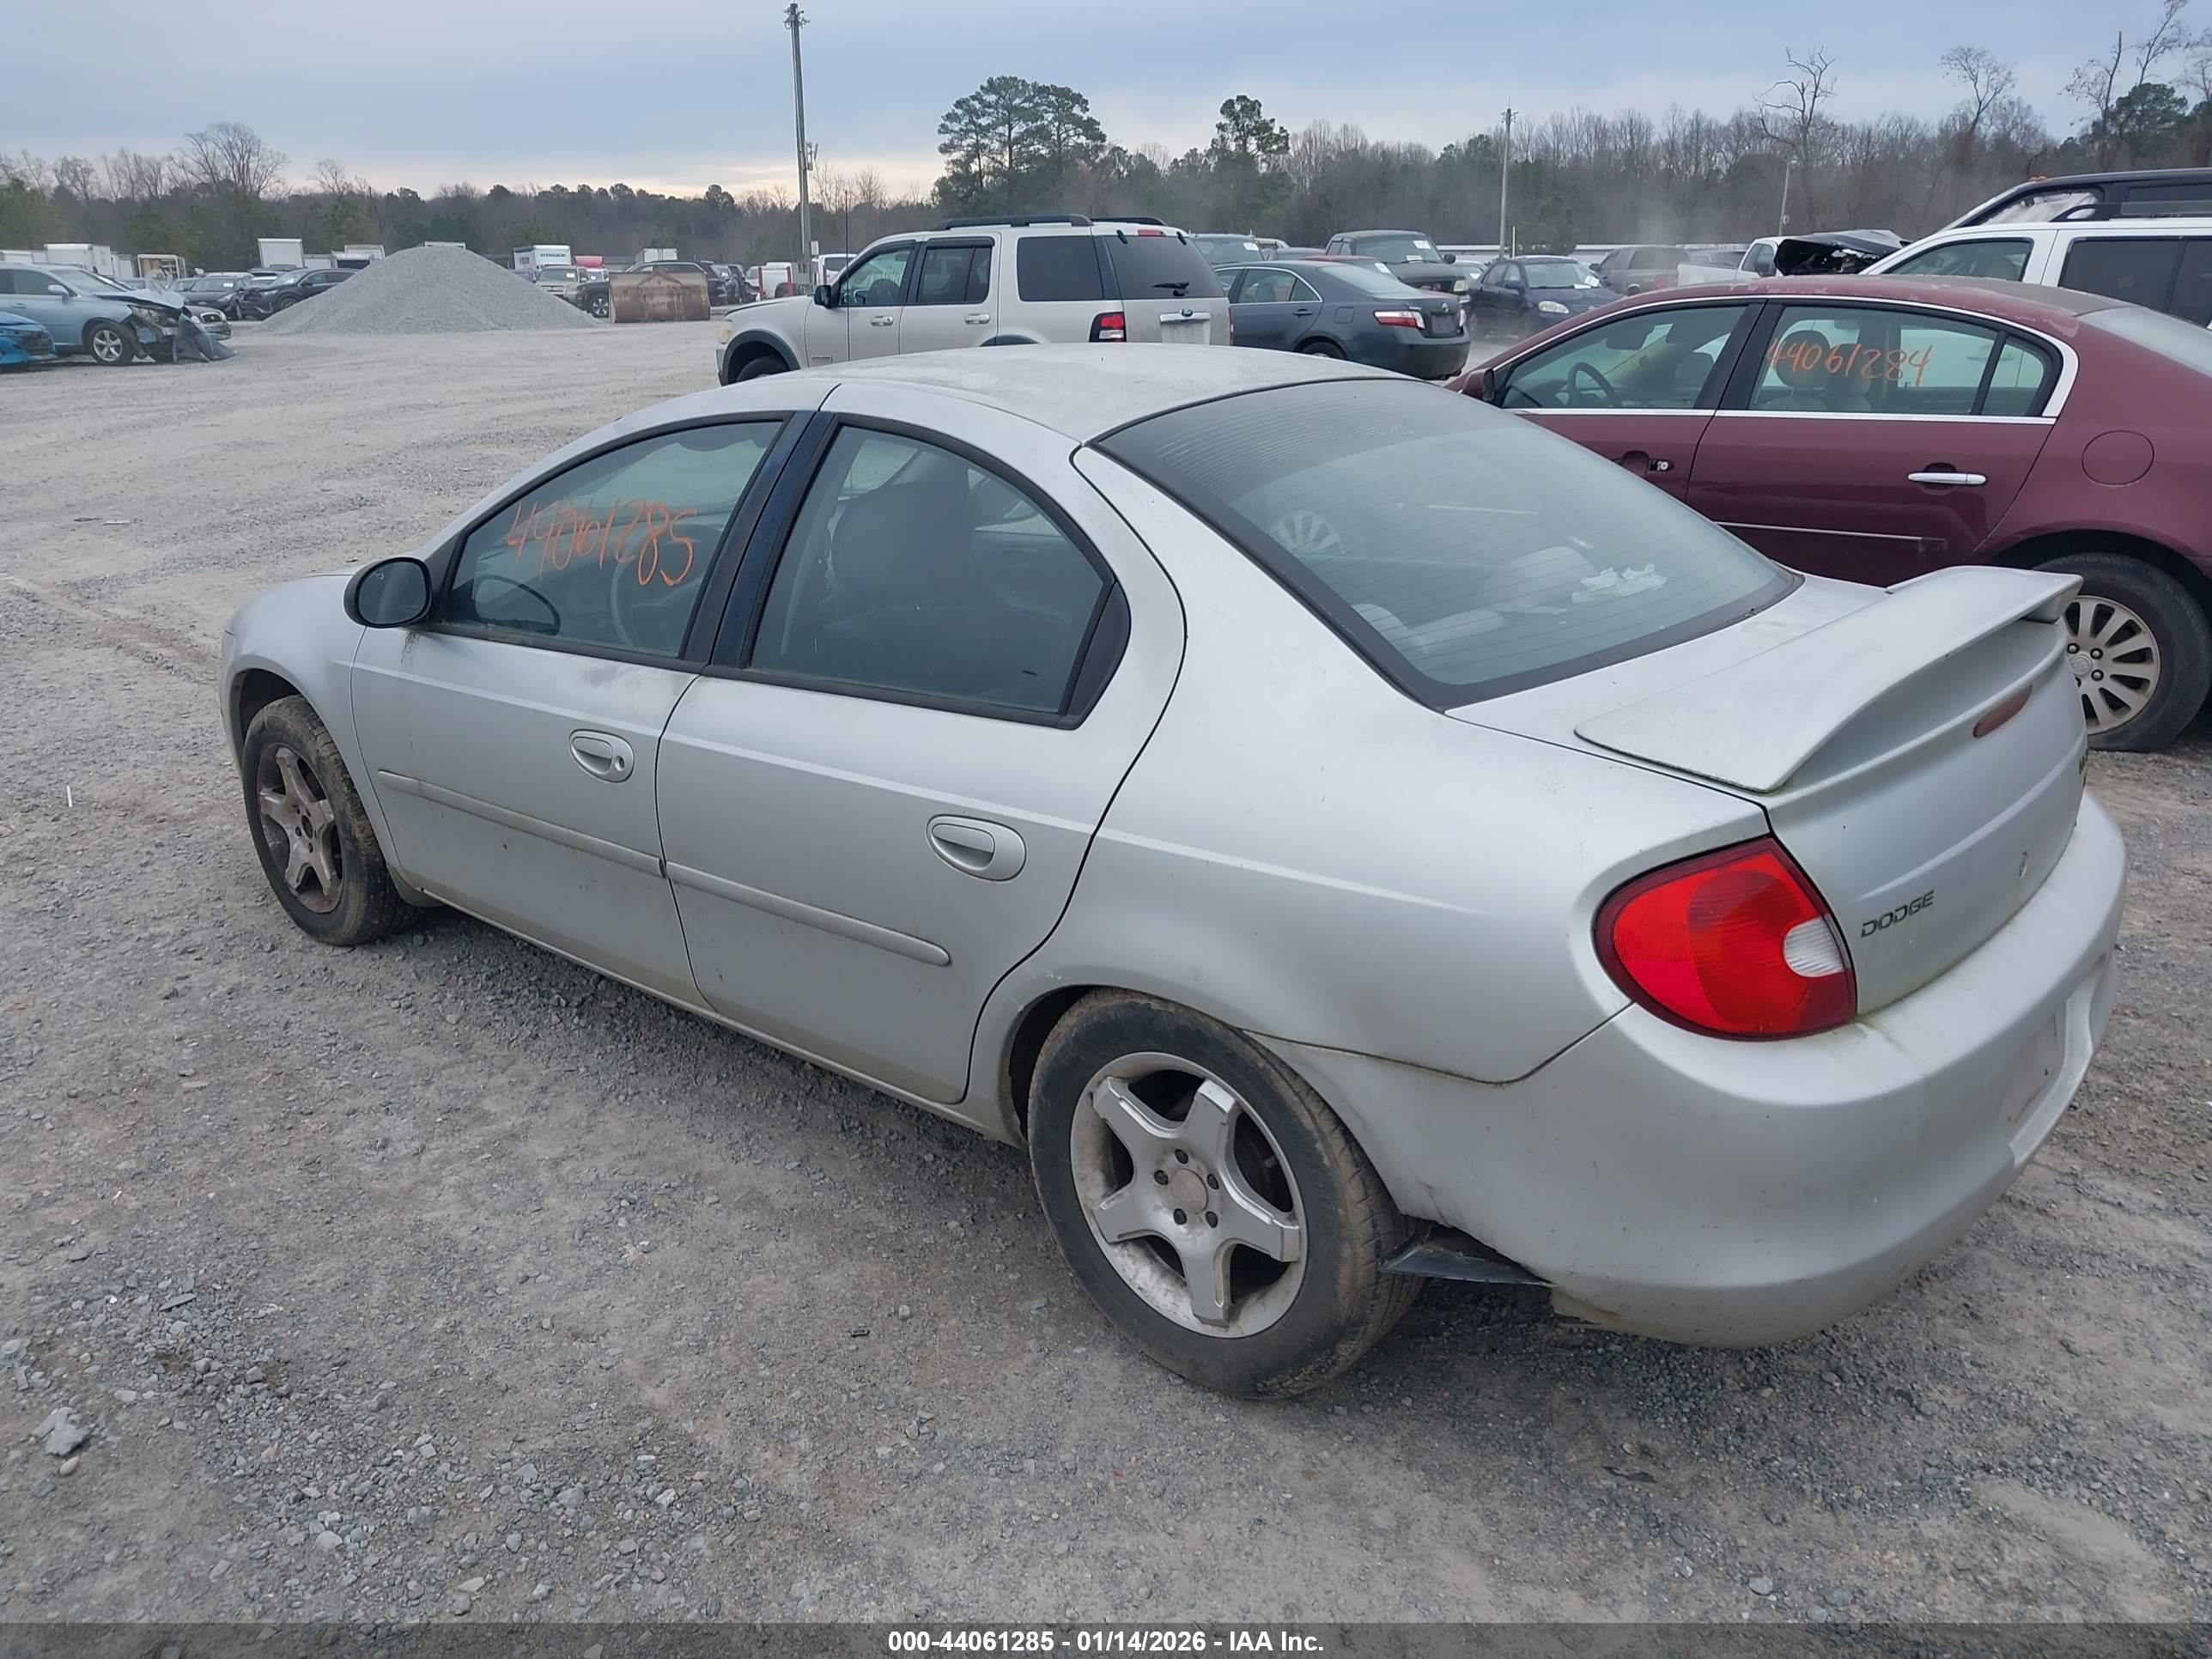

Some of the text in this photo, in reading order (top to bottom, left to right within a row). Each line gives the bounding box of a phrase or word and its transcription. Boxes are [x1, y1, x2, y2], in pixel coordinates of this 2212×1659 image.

[1766, 338, 1933, 387] 44061284
[507, 496, 697, 587] 44061285
[1861, 890, 1935, 939] DODGE
